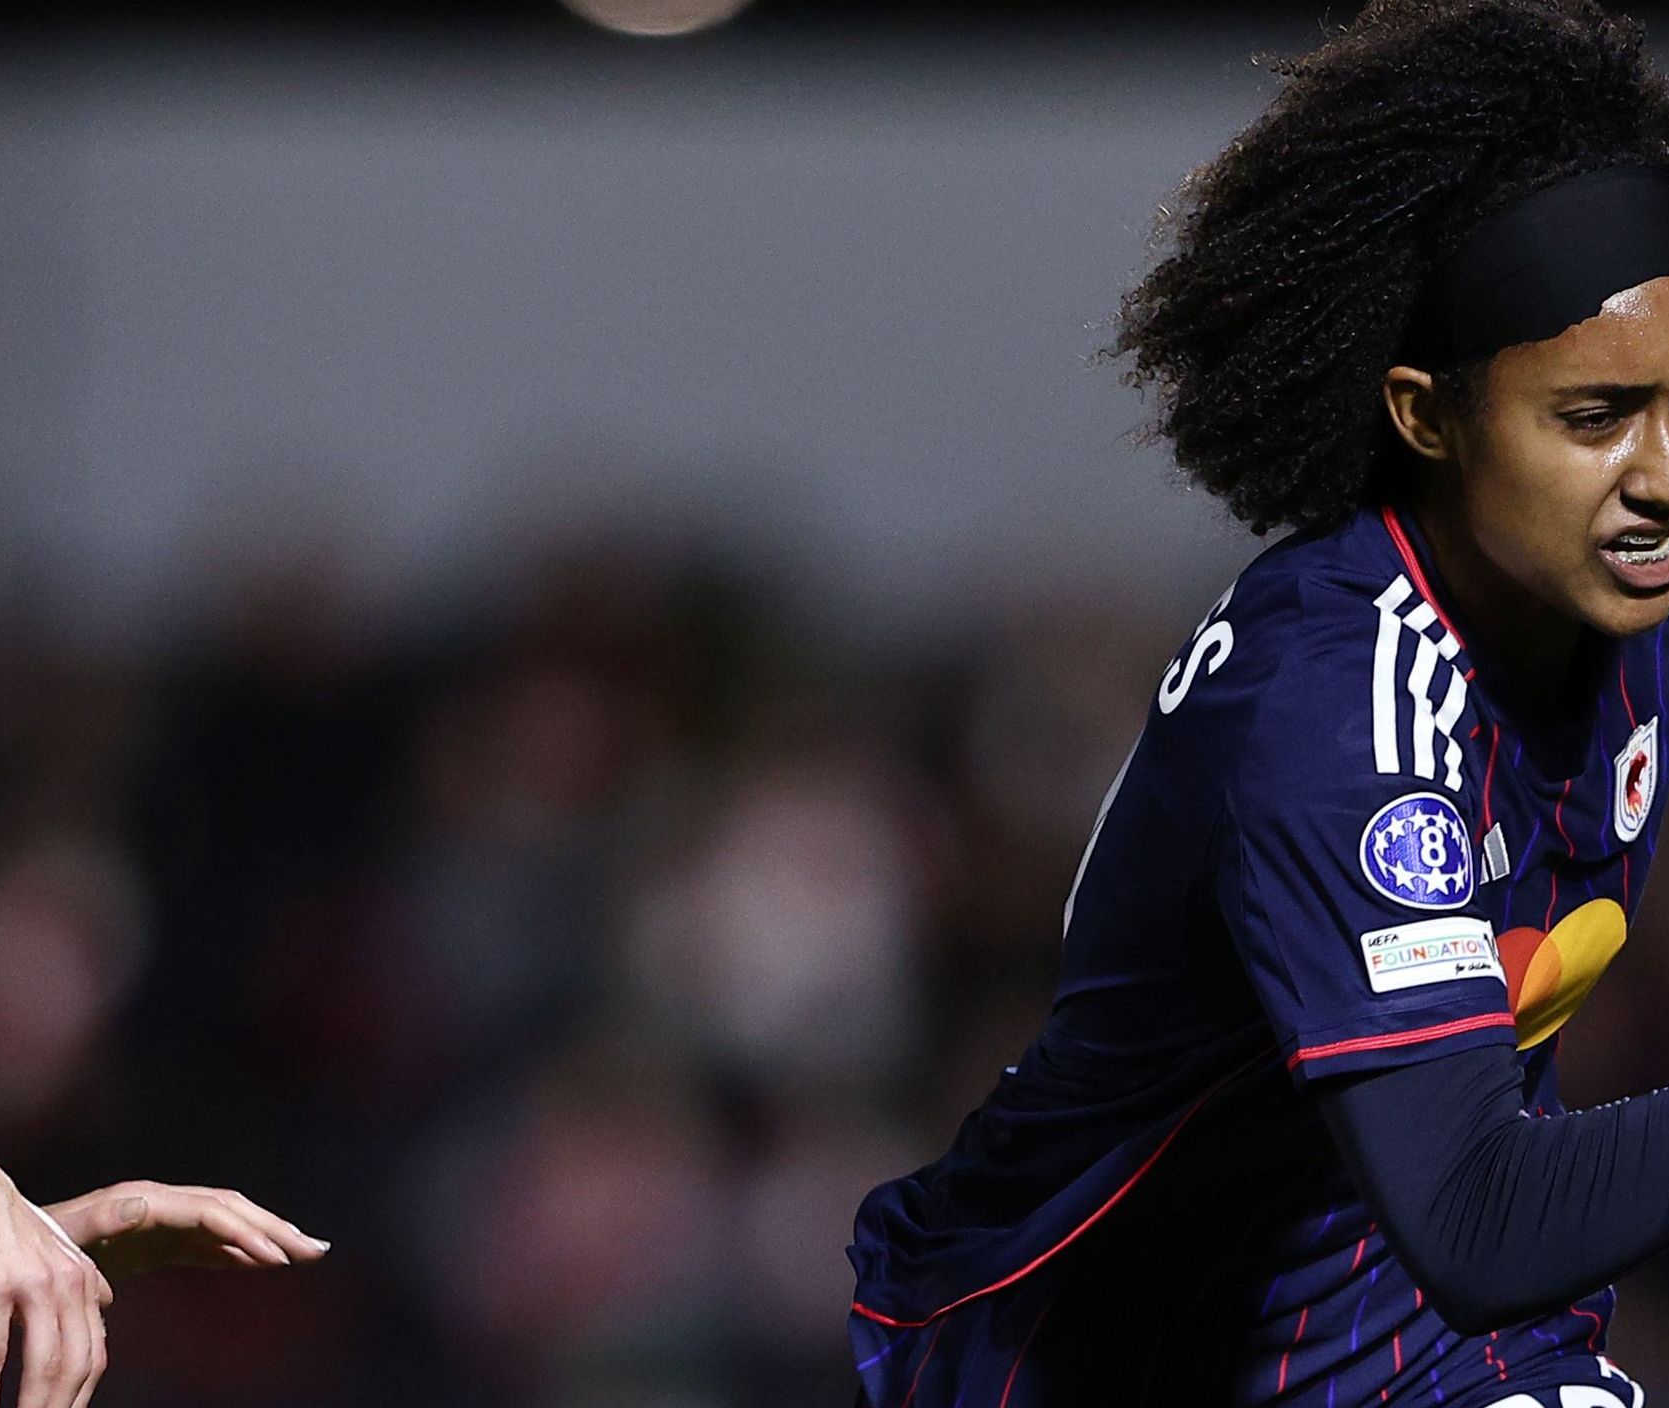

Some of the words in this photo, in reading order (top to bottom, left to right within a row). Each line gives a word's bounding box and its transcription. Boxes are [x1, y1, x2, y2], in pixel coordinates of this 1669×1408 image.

[1419, 826, 1447, 867] 8
[1368, 934, 1399, 947] UEFA
[1372, 940, 1487, 969] FOUNDATION
